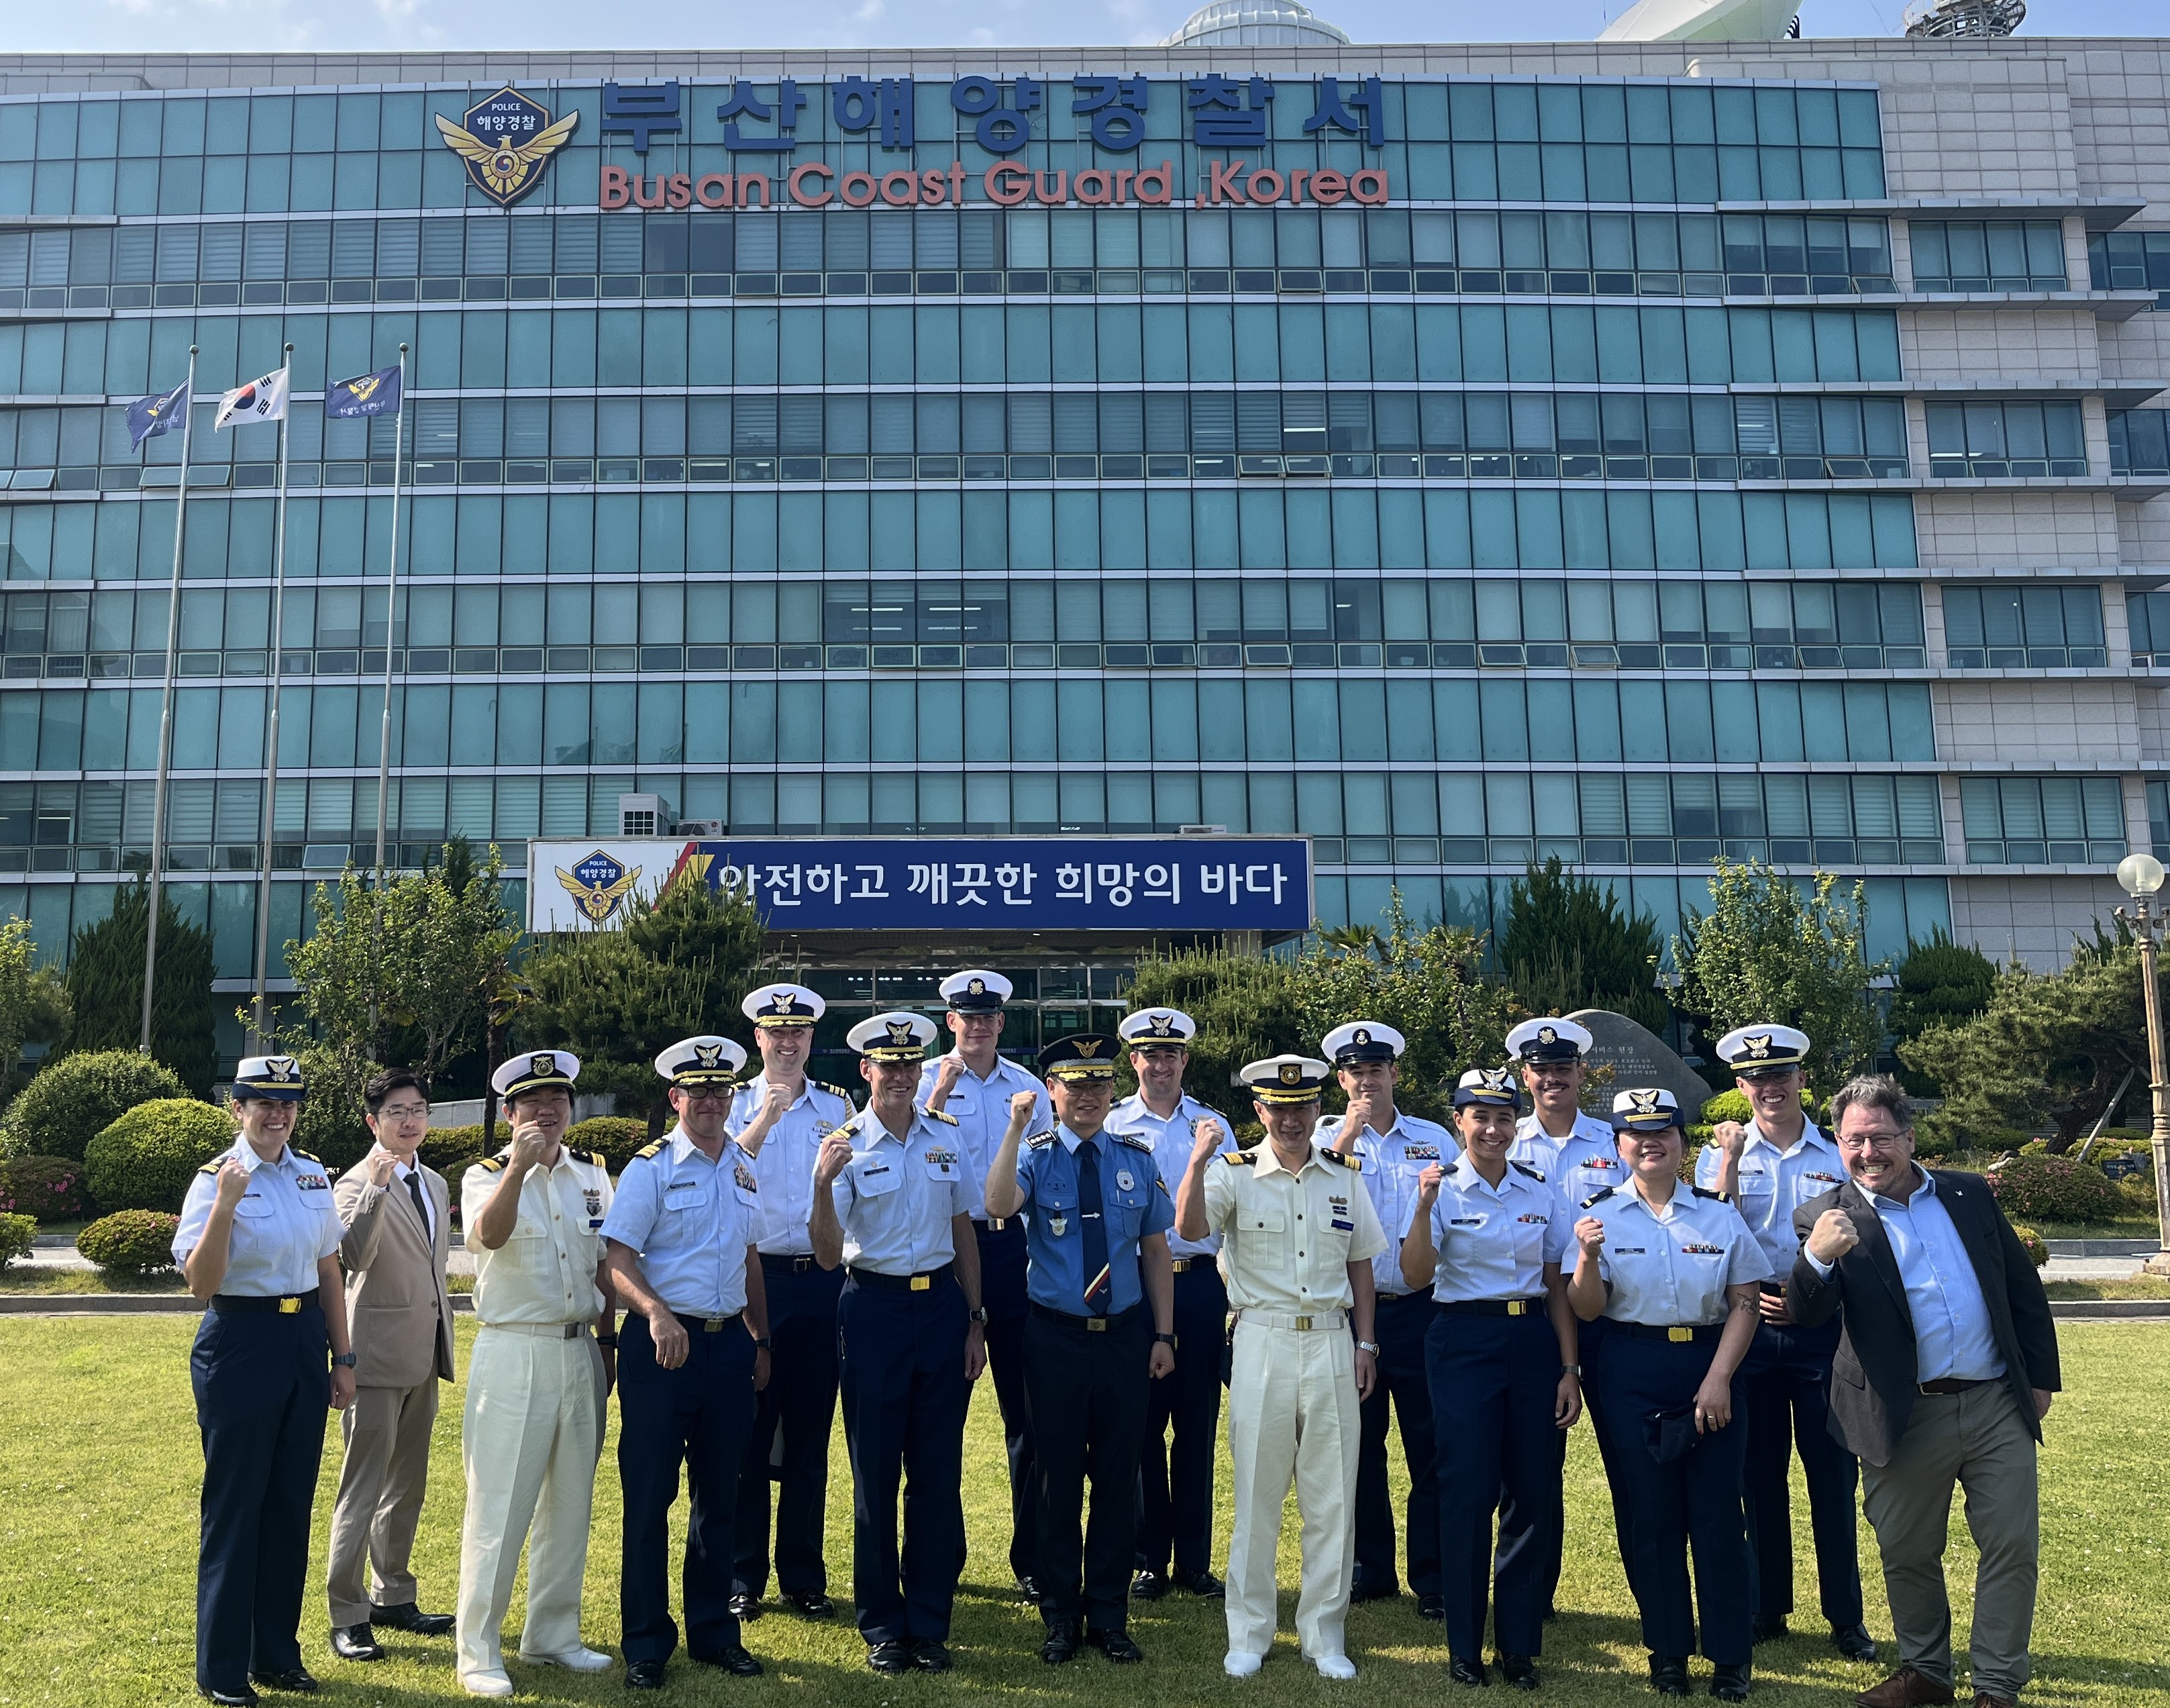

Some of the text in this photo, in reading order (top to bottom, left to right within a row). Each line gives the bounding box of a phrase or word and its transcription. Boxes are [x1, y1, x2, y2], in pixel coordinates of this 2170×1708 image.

[491, 103, 521, 111] POLICE
[602, 74, 1384, 153] 부산해양경찰서
[476, 115, 536, 131] 해양경찰
[601, 166, 770, 209] Busan
[789, 162, 965, 206] Coast
[984, 160, 1172, 204] Guard
[580, 868, 616, 879] 해양경찰
[720, 863, 1288, 907] 안전하고 깨끗한 희망의 바다
